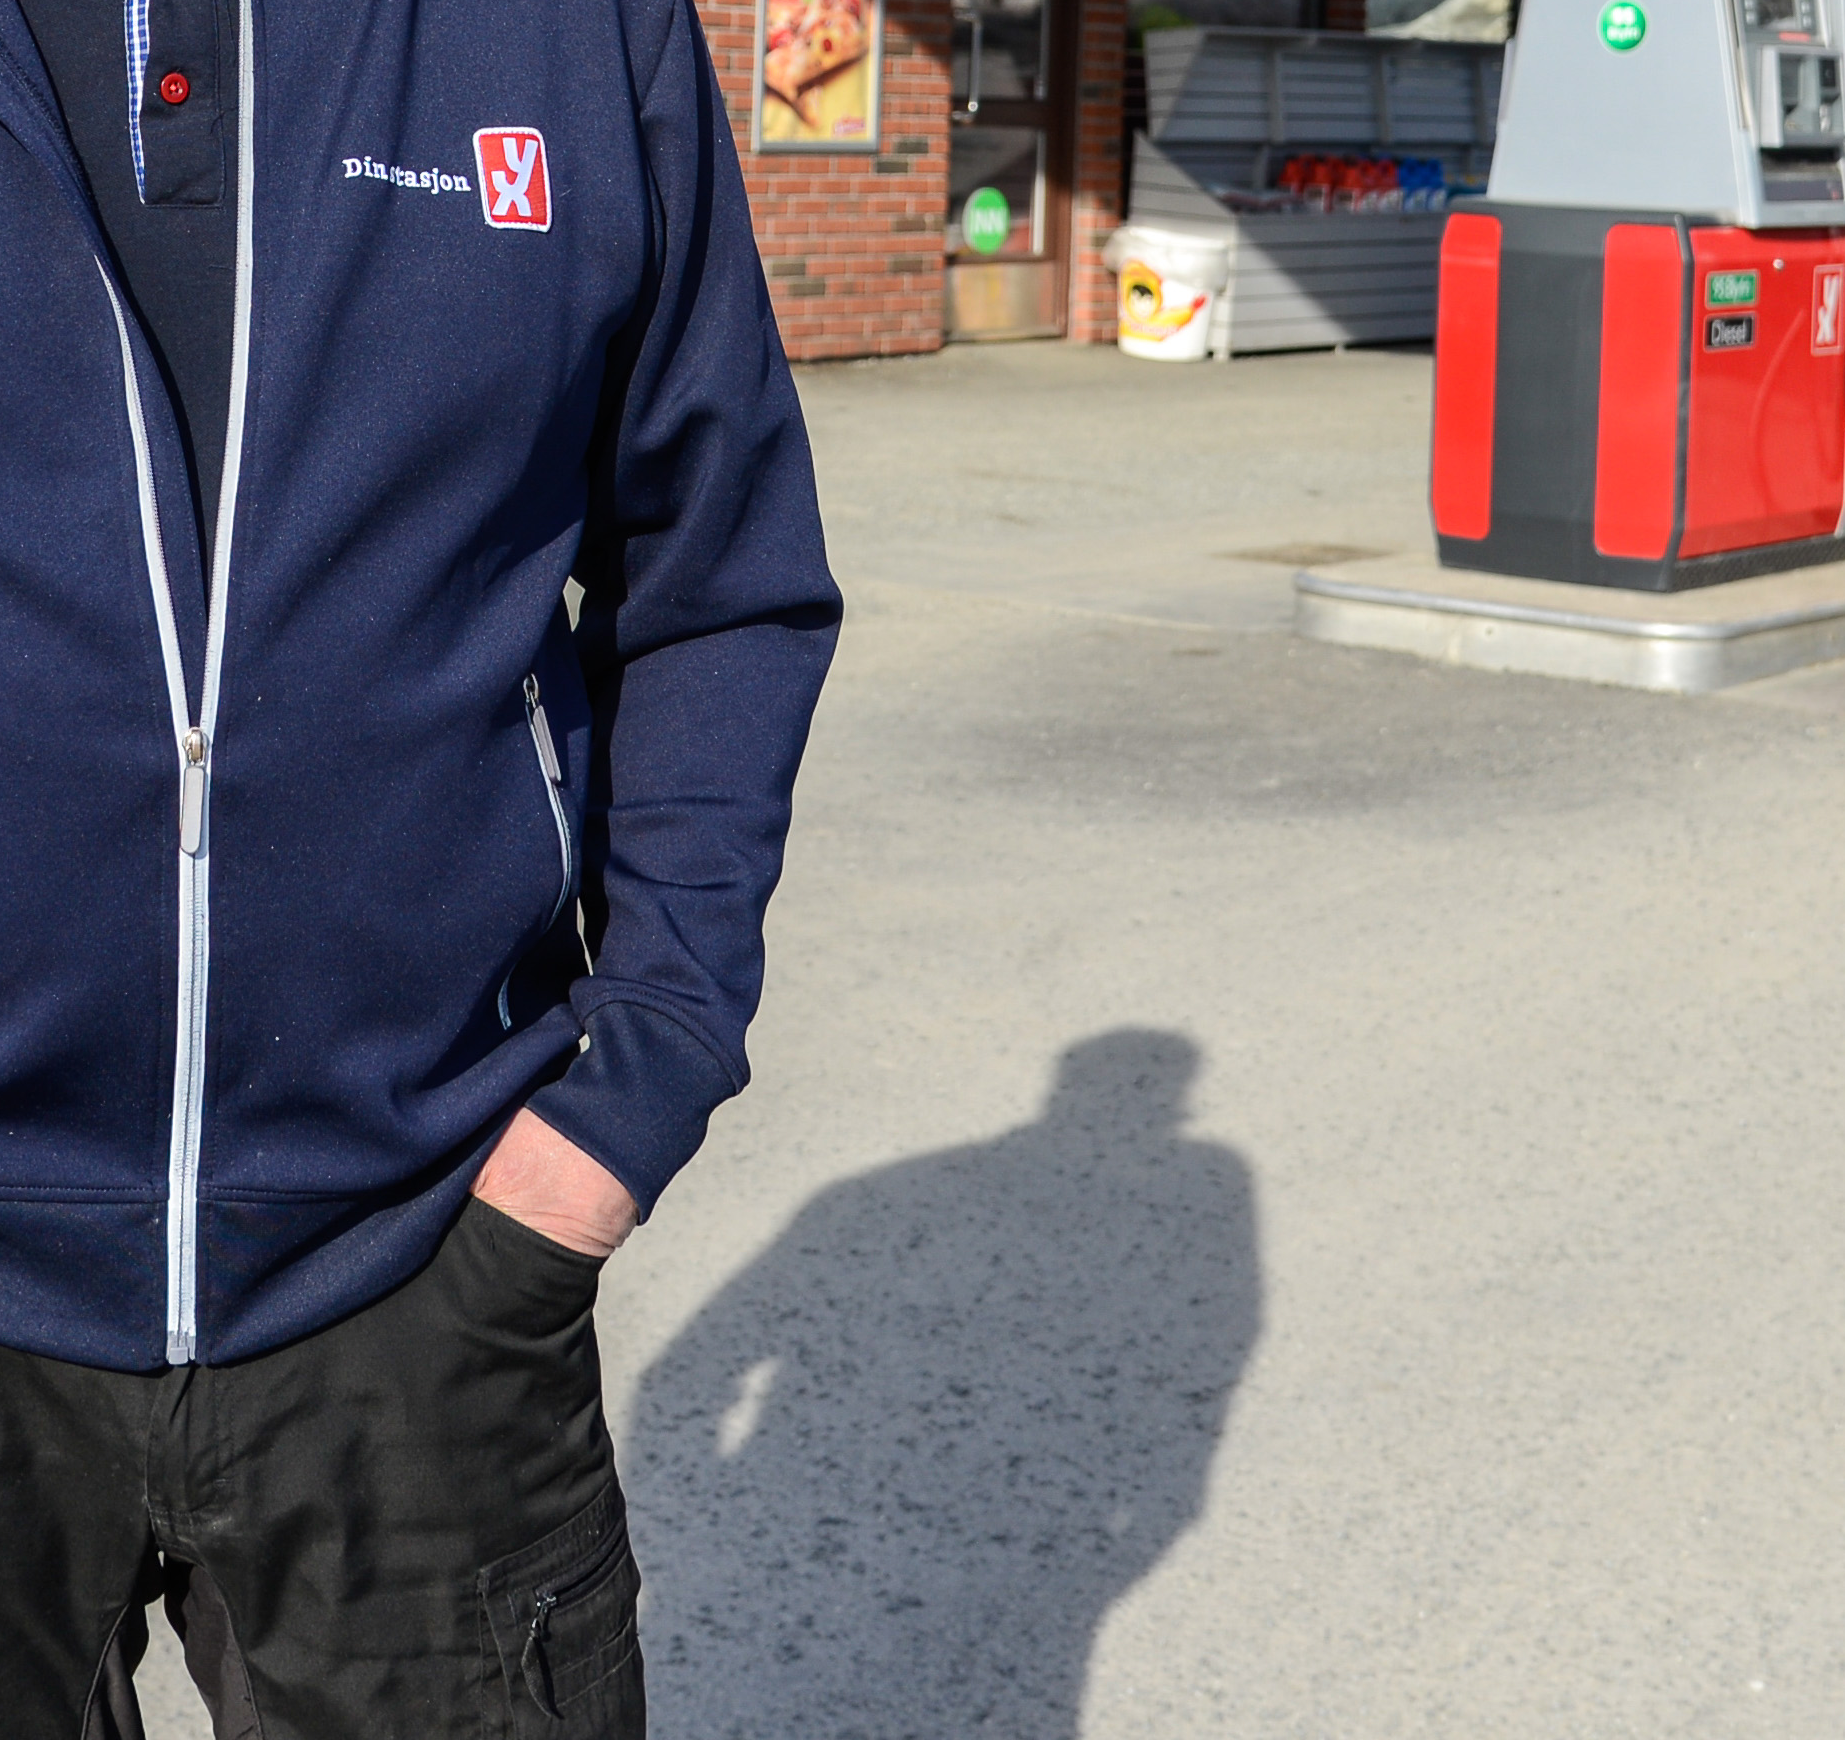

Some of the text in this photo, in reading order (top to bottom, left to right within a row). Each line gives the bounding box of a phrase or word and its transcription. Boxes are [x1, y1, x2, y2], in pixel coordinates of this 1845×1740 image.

[342, 155, 389, 179] Din
[388, 165, 472, 195] stasjon
[1711, 317, 1748, 347] Diesel
